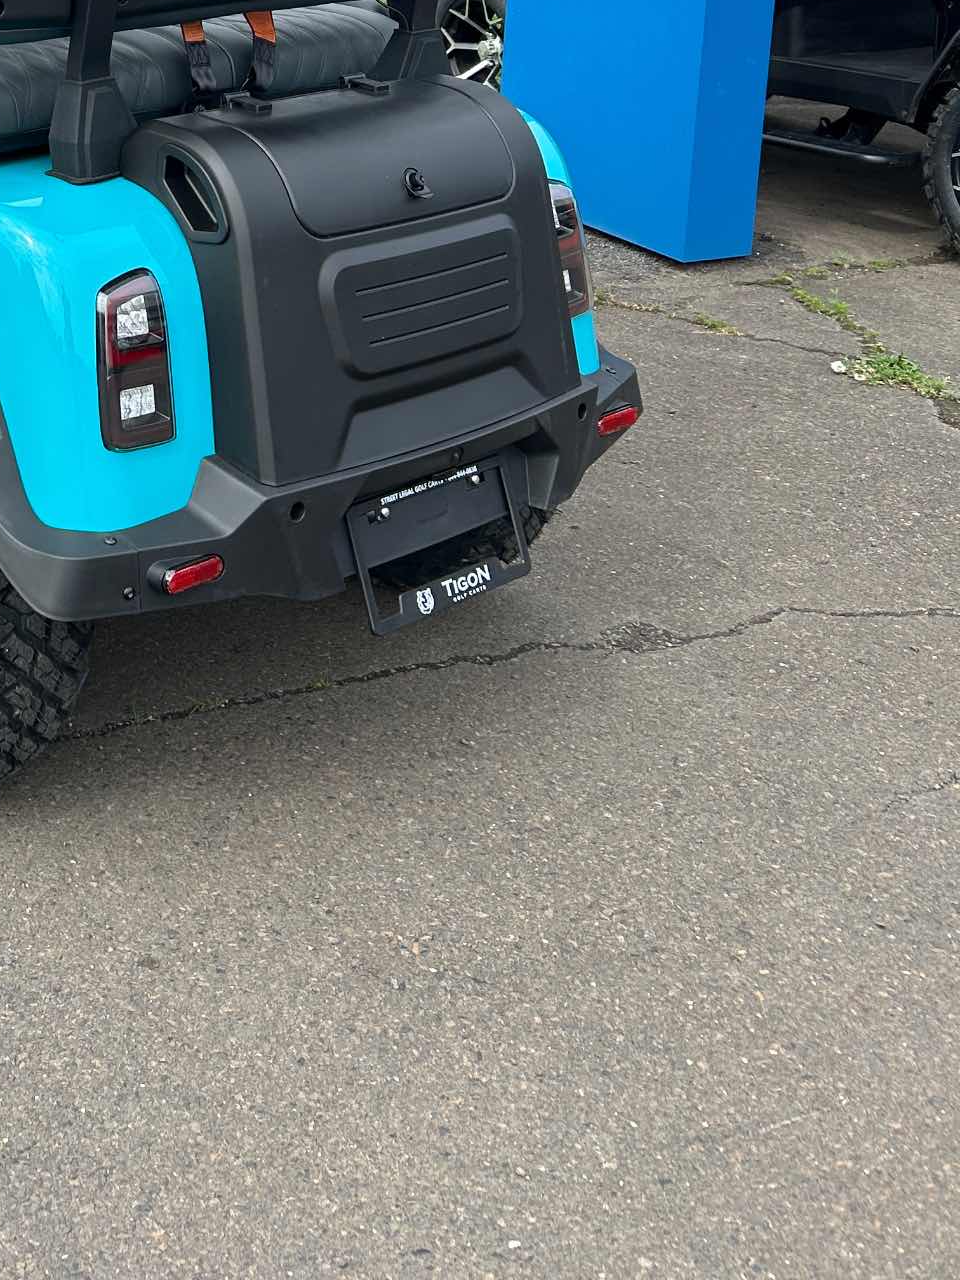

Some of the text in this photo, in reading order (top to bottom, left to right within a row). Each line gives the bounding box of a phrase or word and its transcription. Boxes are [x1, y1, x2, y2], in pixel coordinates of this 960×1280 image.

[414, 483, 428, 493] GOLF
[441, 564, 491, 597] TIGON
[452, 584, 487, 603] GOLF CARTS
